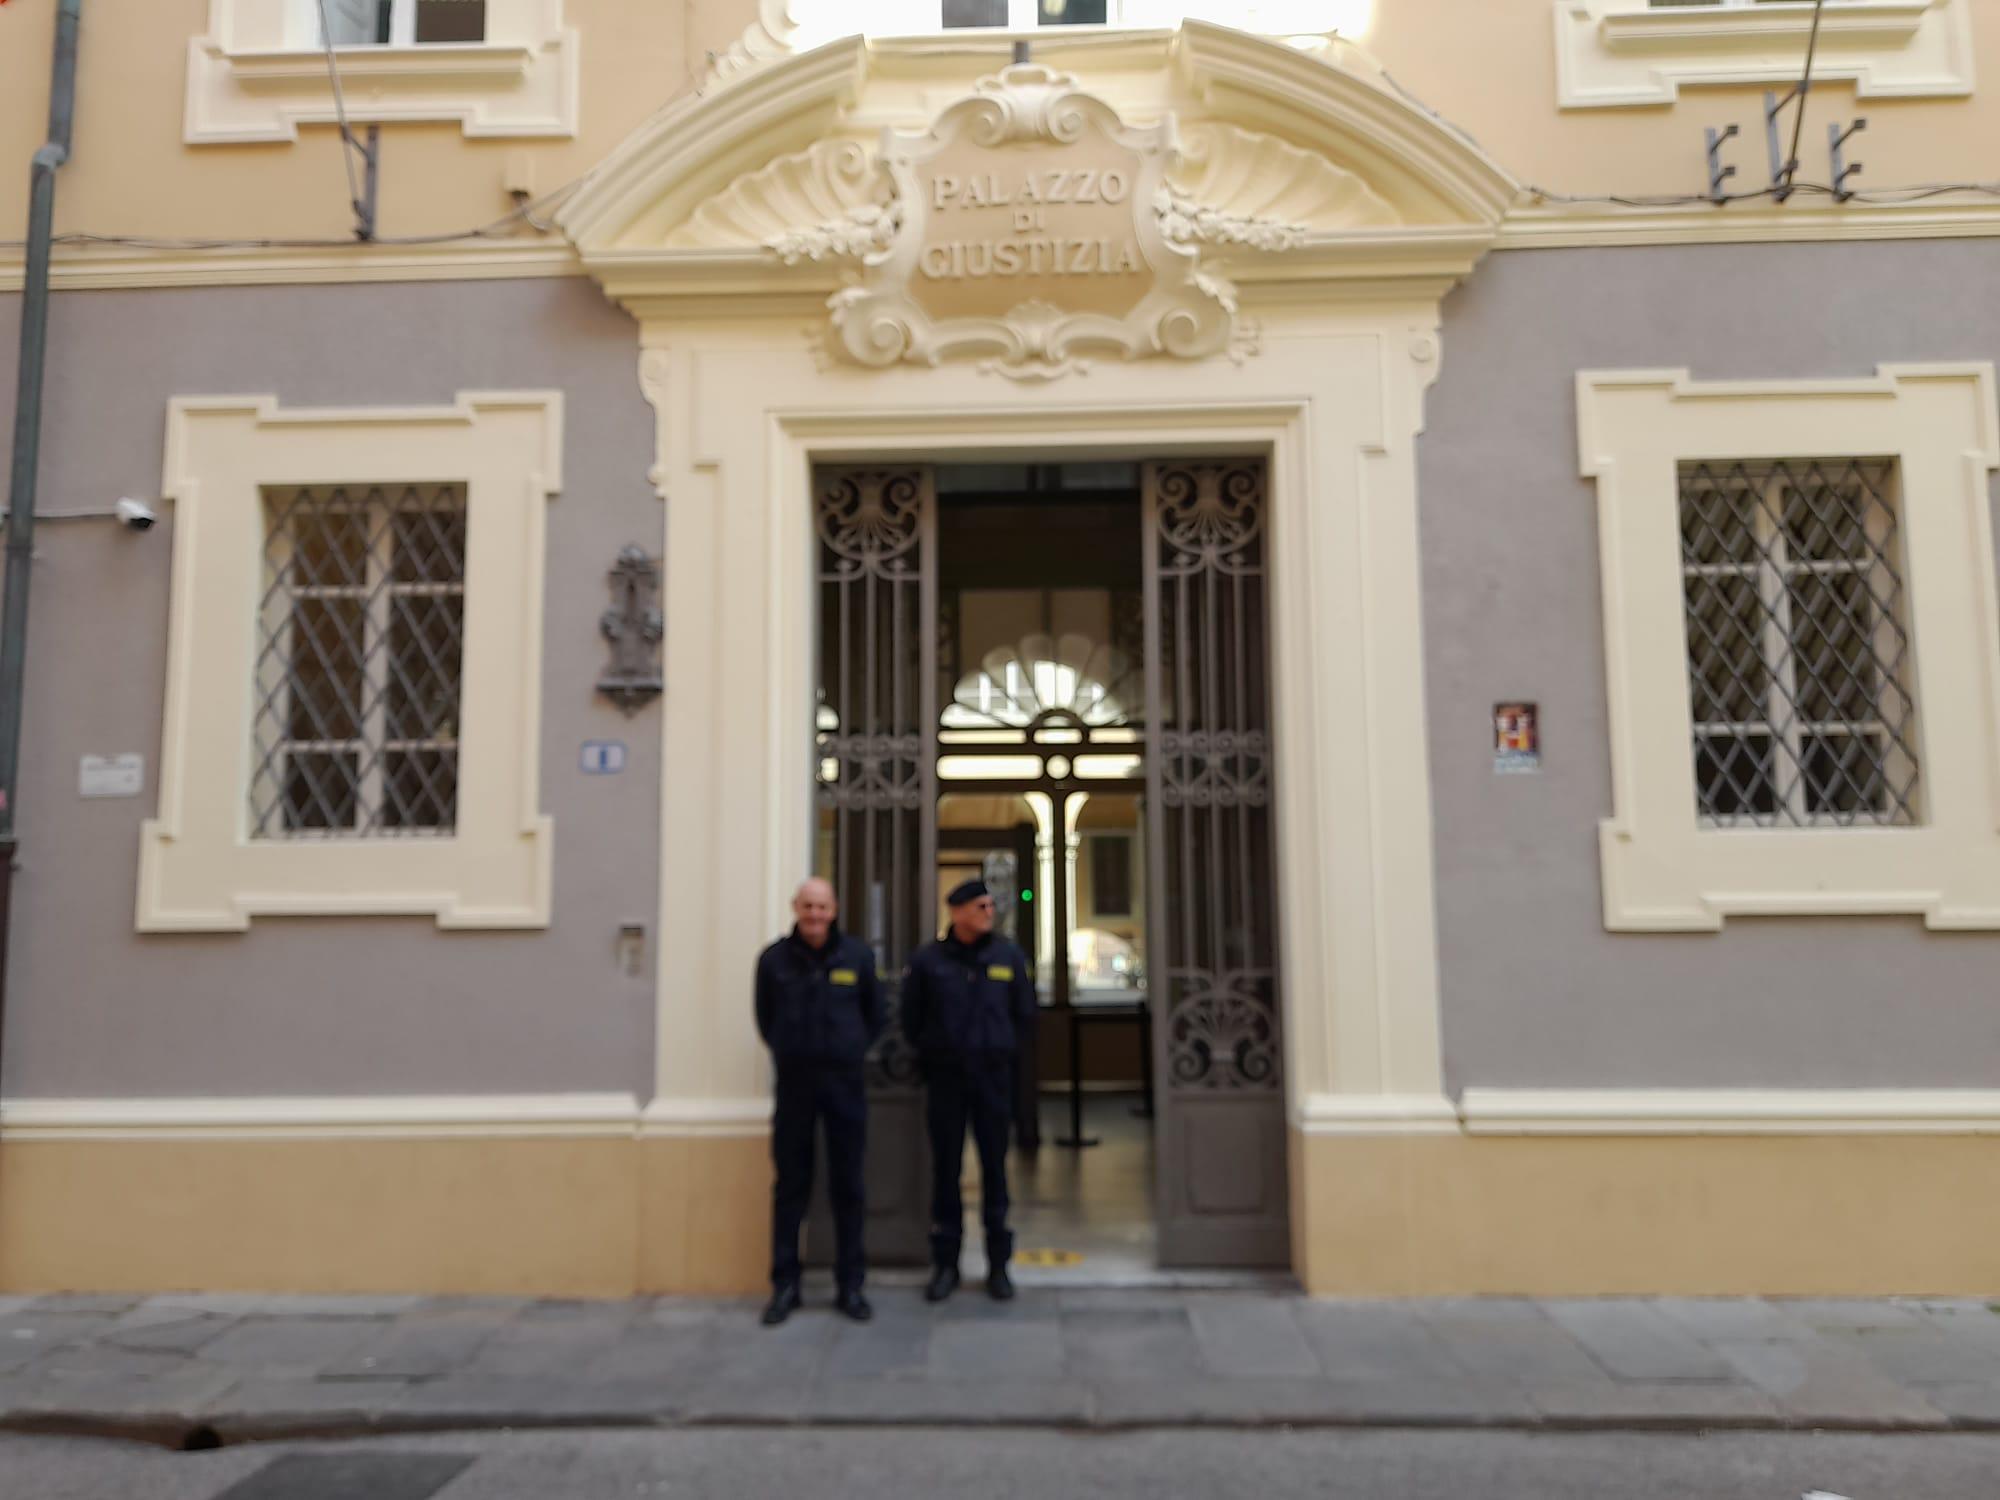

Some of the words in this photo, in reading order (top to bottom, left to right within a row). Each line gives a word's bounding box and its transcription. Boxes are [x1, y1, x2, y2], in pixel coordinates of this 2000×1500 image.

[933, 168, 1129, 211] PALAZZO
[1014, 209, 1044, 233] DI
[919, 238, 1141, 281] GIUSTIZIA
